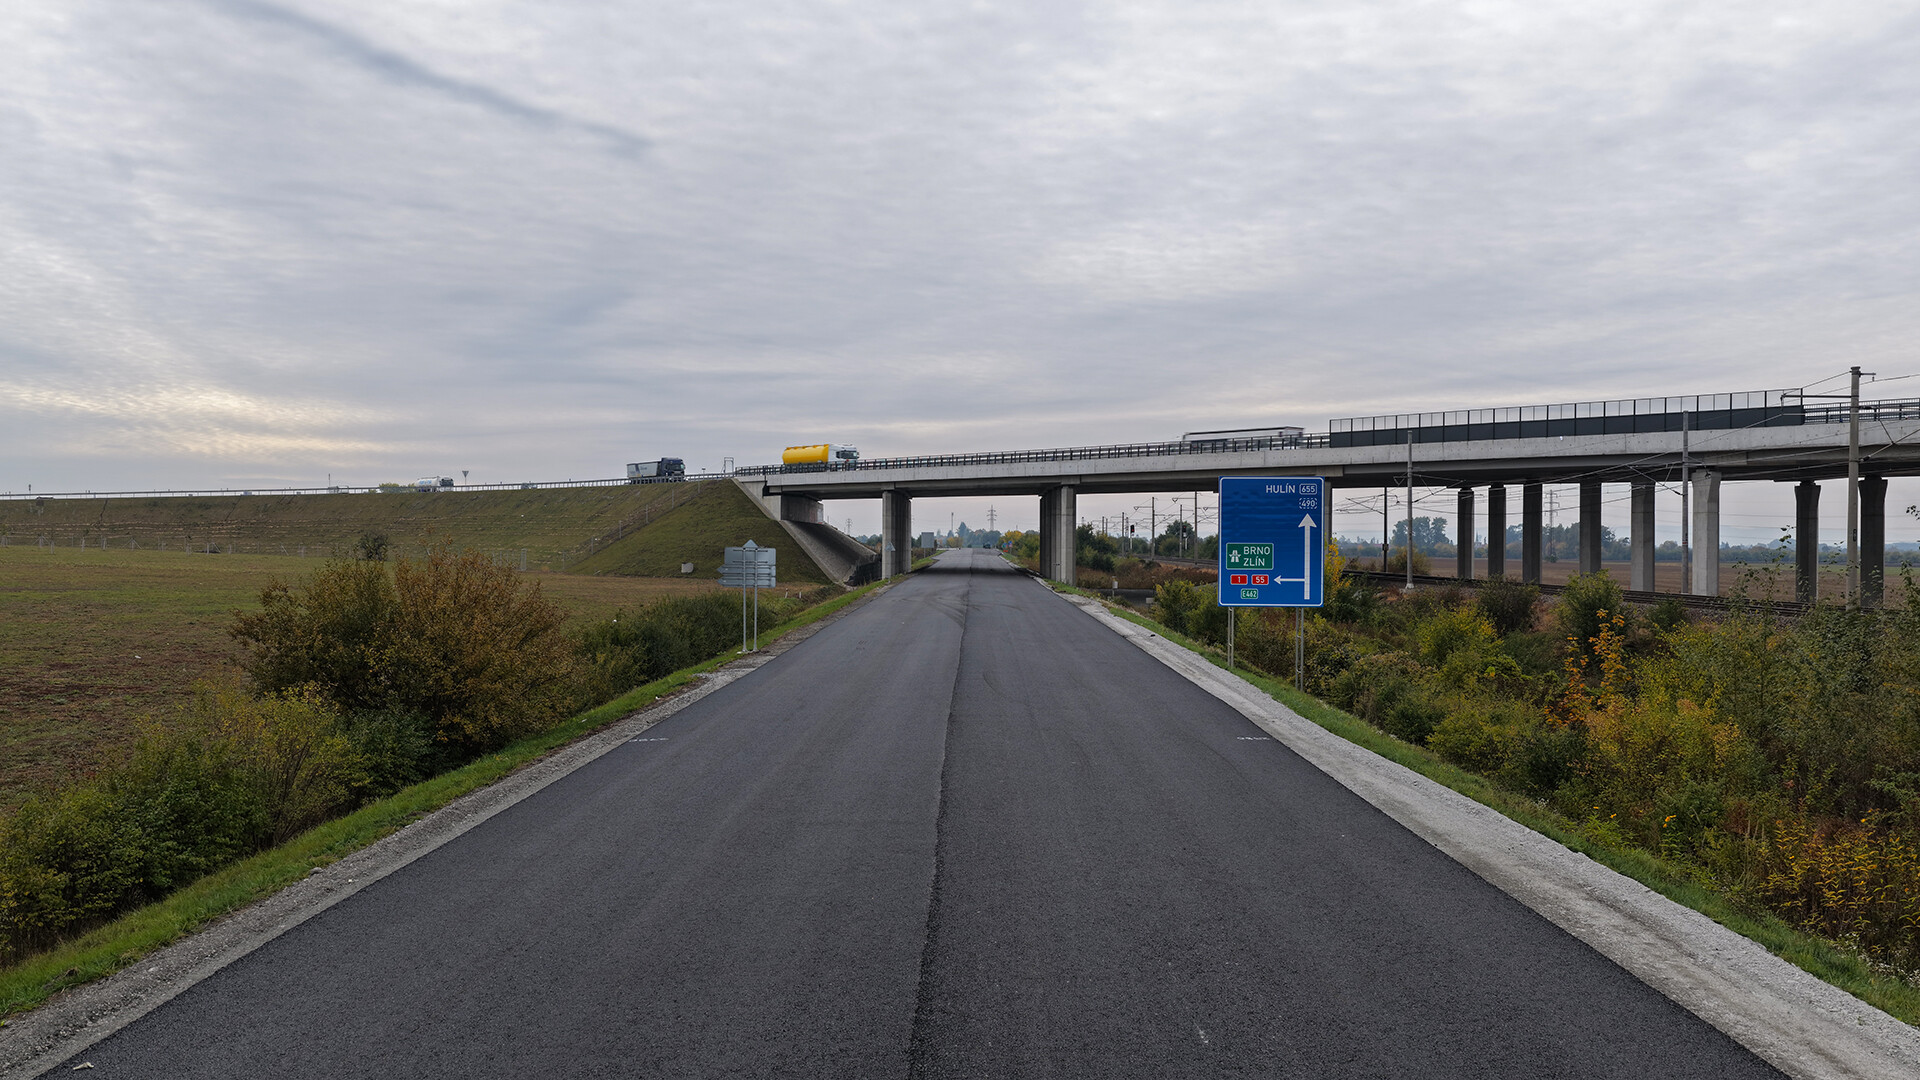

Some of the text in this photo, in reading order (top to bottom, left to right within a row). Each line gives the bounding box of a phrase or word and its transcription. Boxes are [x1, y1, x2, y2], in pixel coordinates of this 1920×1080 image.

[1266, 483, 1296, 493] HULÍN
[1243, 546, 1270, 555] BRNO
[1243, 556, 1265, 566] ZLÍN
